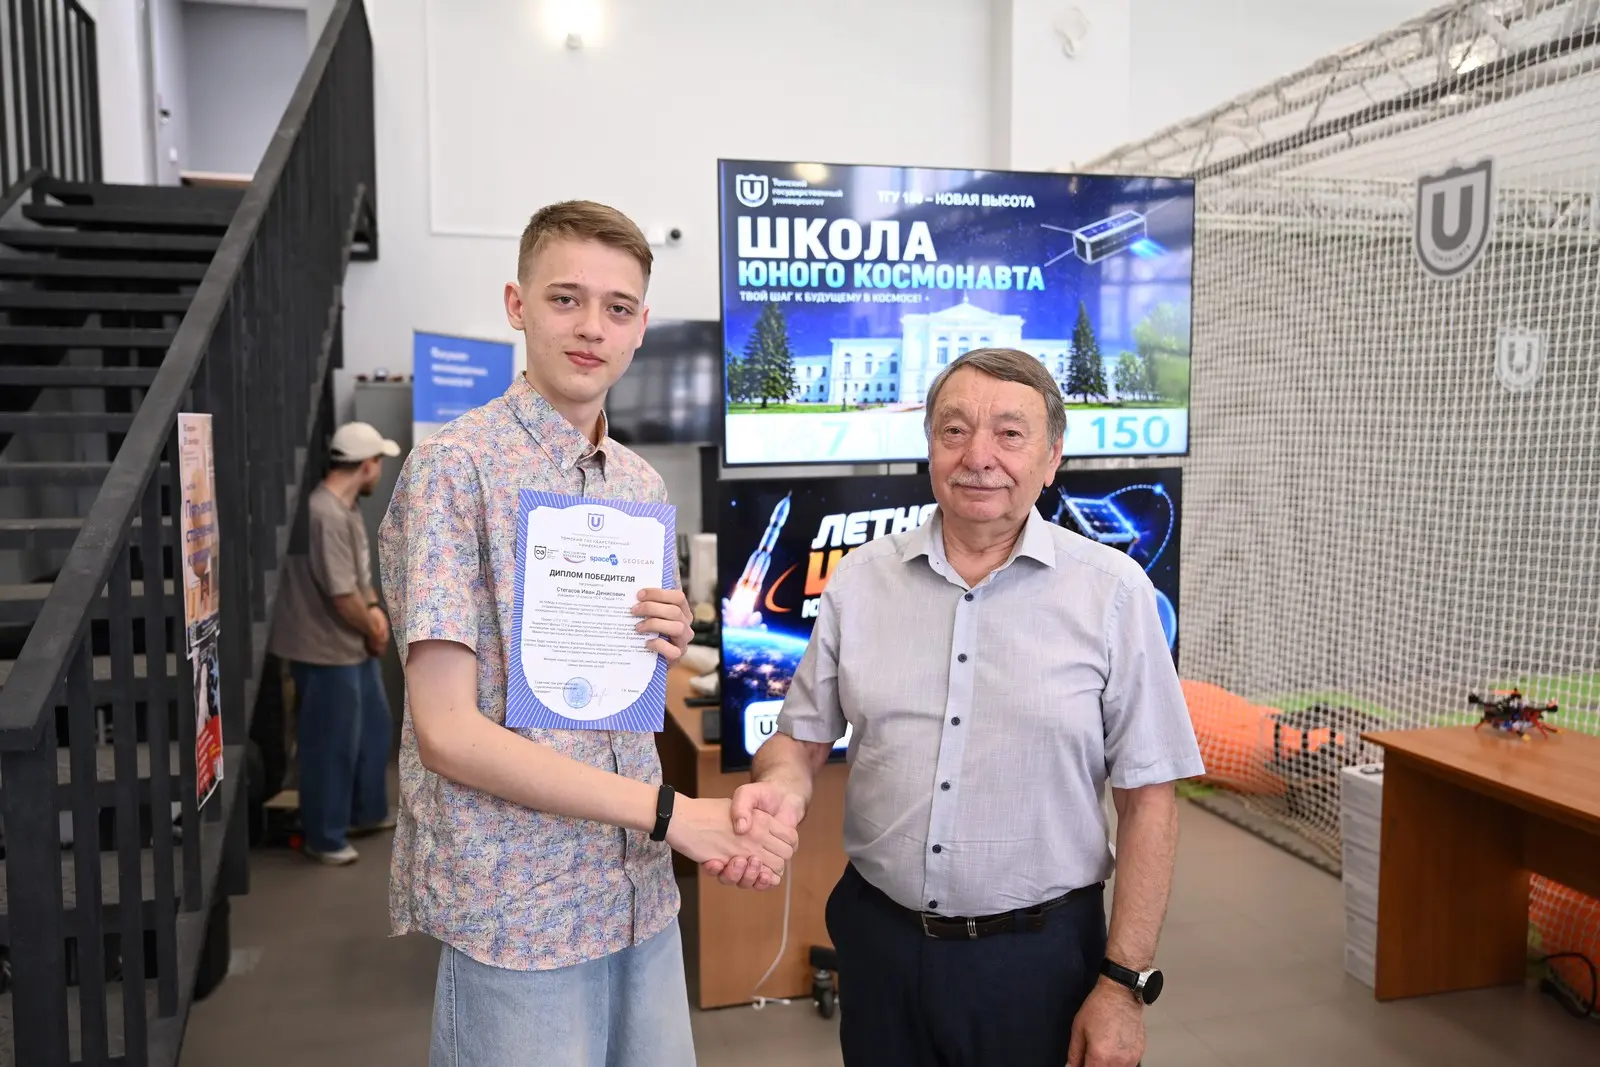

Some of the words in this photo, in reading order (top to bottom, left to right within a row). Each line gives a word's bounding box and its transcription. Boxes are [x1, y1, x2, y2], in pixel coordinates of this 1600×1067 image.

[935, 192, 980, 207] НОВАЯ
[981, 194, 1036, 209] ВЫСОТА
[737, 215, 938, 262] ШКОЛА
[738, 260, 845, 288] ЮНОГО
[854, 262, 1046, 291] КОСМОНАВТА
[739, 290, 768, 302] ТВОЙ
[769, 291, 794, 302] ШАГ
[795, 292, 804, 302] К
[804, 292, 862, 304] БУДУЩЕМУ
[863, 293, 872, 303] В
[1090, 415, 1170, 449] 150
[549, 569, 583, 579] ДИПЛОМ
[585, 572, 636, 583] ПОБЕДИТЕЛЯ
[556, 586, 580, 594] Стегасов
